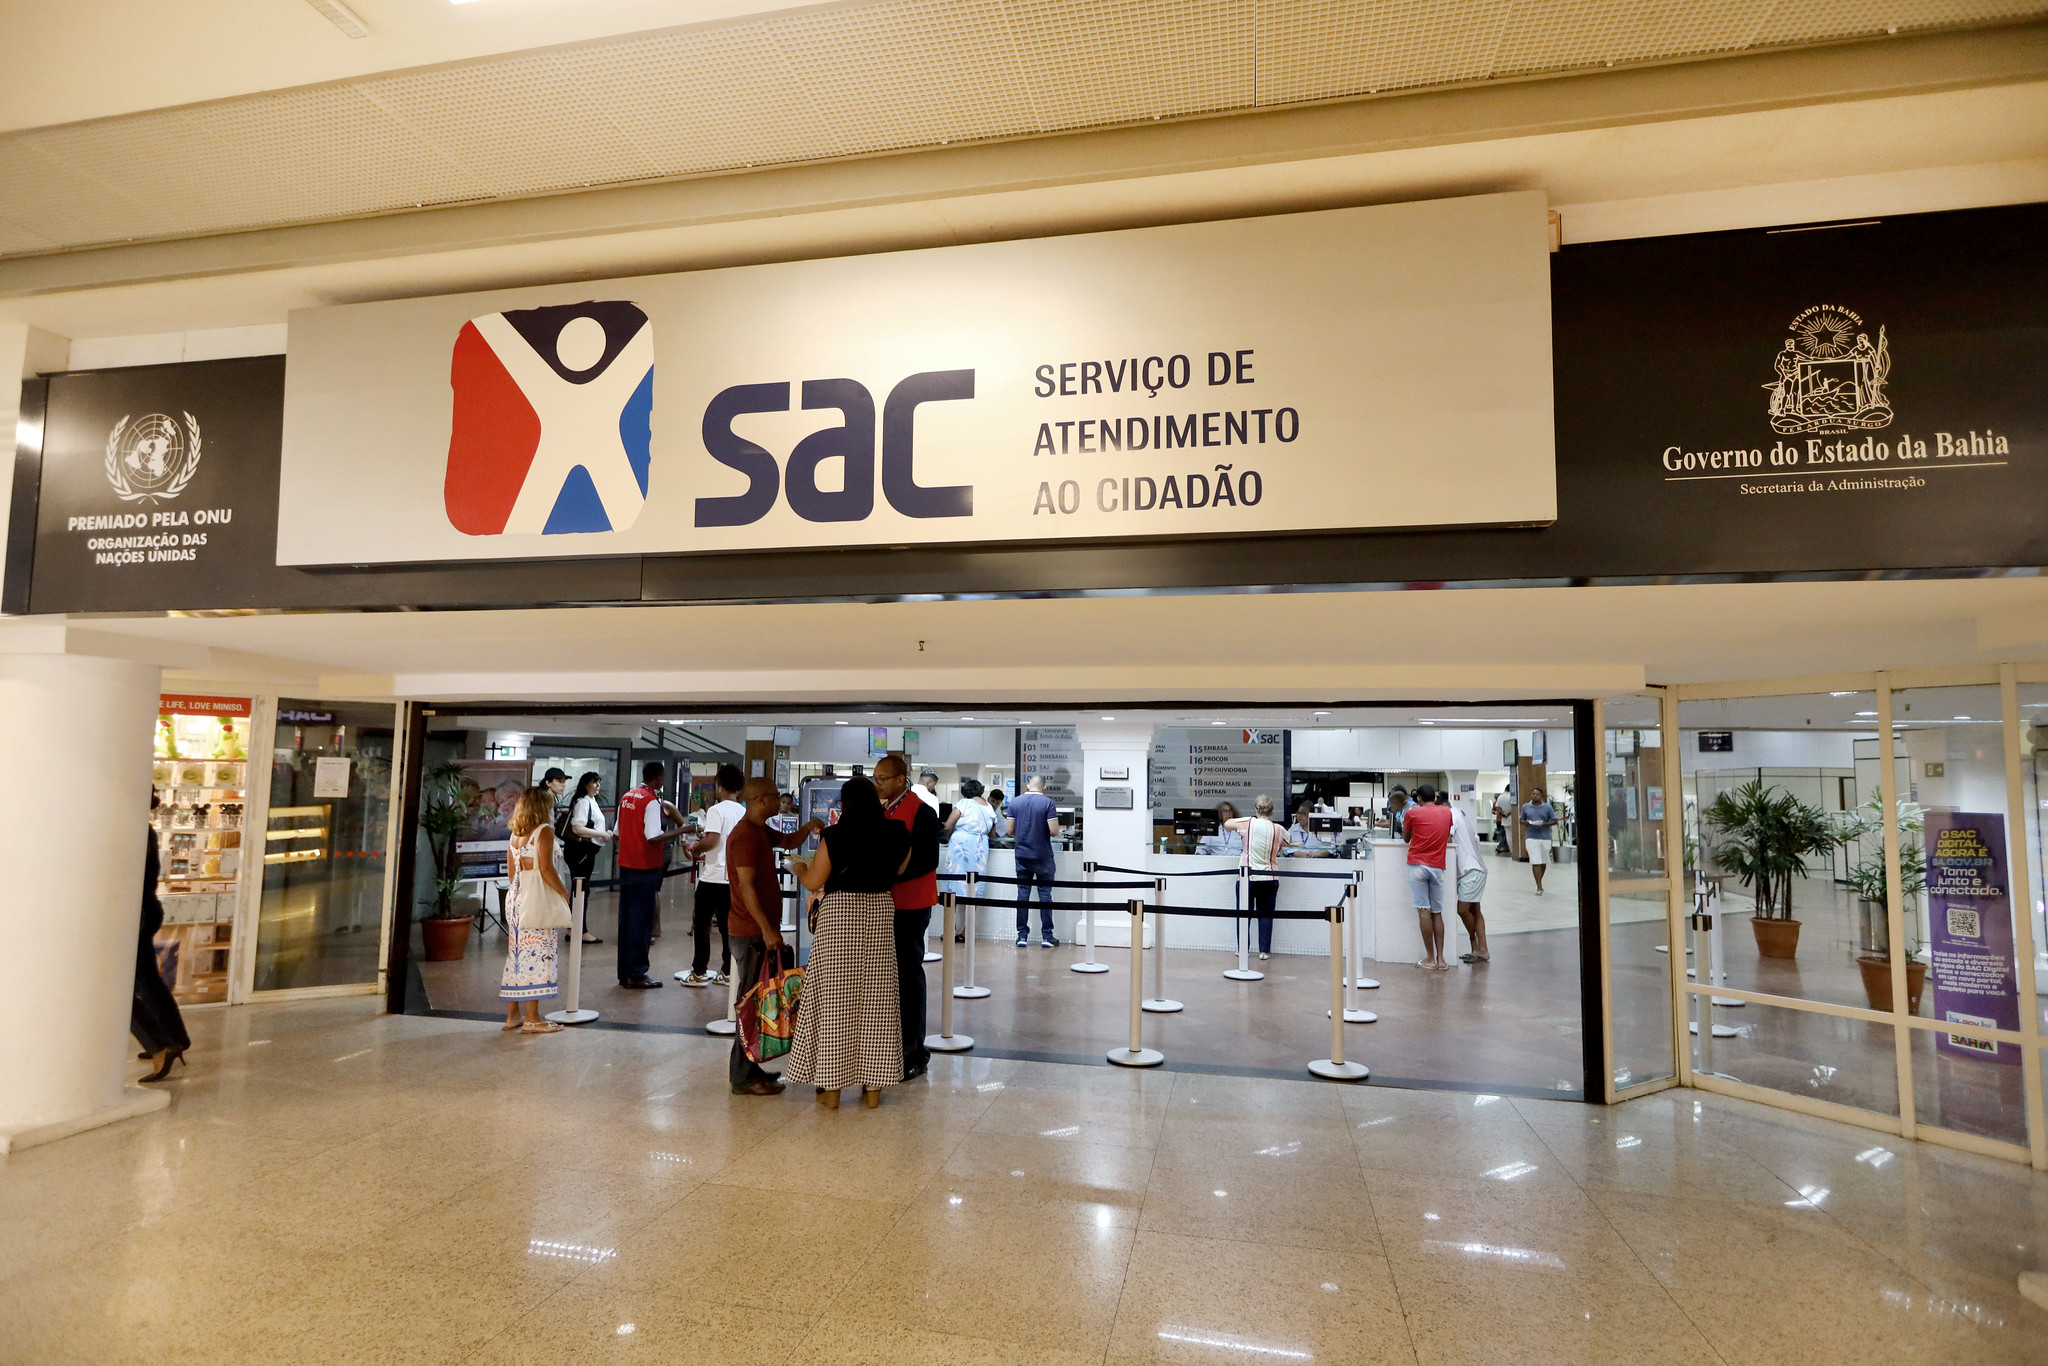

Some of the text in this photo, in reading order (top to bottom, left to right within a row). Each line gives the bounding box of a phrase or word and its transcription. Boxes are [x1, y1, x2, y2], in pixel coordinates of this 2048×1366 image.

[1788, 305, 1819, 331] ESTADO
[1837, 305, 1863, 326] BAHIA
[1034, 349, 1256, 398] SERVIÇO DE
[1033, 406, 1300, 457] ATENDIMENTO
[694, 369, 975, 528] sac
[1662, 430, 2009, 472] Governo do Estado da Bahia
[1033, 463, 1263, 516] AO CIDADÃO
[1740, 475, 1925, 495] Secretaria da Administração
[68, 509, 232, 531] PREMIADO PELA ONU
[87, 532, 208, 550] ORGANIZAÇÃO DAS
[95, 548, 197, 567] NAÇÕES UNIDAS
[166, 701, 187, 710] LIFE,
[190, 702, 212, 710] LOVE
[212, 703, 245, 711] MINISO.
[1260, 734, 1280, 744] sac
[1193, 756, 1203, 764] 16
[1194, 789, 1203, 797] 19
[1940, 830, 1976, 838] O SAC
[1937, 839, 1981, 847] DIGITAL
[1935, 847, 1988, 857] AGORA É
[1932, 858, 1993, 866] BA.GOV.BR
[1941, 867, 1977, 876] Tamo
[1937, 876, 1982, 886] junto e
[1930, 884, 2003, 895] conectado.
[1957, 952, 2005, 961] informações
